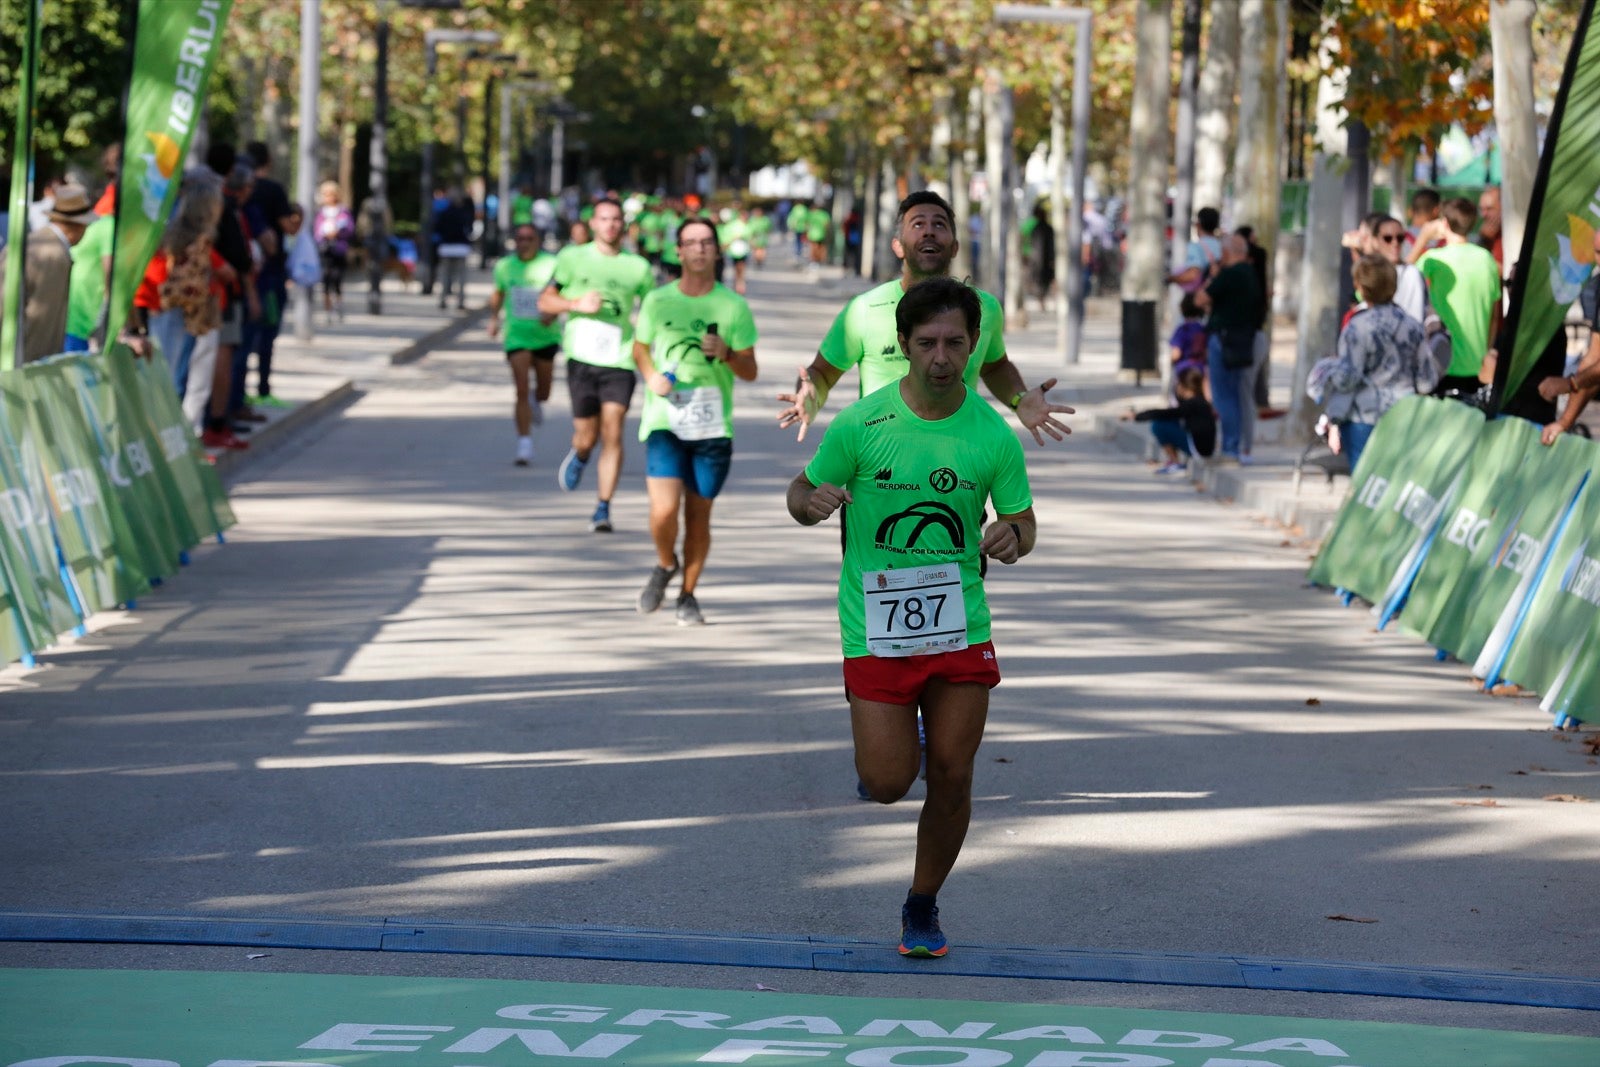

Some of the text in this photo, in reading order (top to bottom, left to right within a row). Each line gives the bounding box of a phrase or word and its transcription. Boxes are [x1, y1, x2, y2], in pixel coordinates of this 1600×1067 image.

[876, 481, 921, 491] IBERDROLA
[885, 545, 907, 555] FORMA
[880, 594, 947, 632] 787
[296, 1022, 1362, 1067] EN FOR
[495, 1004, 1350, 1057] GRANADA
